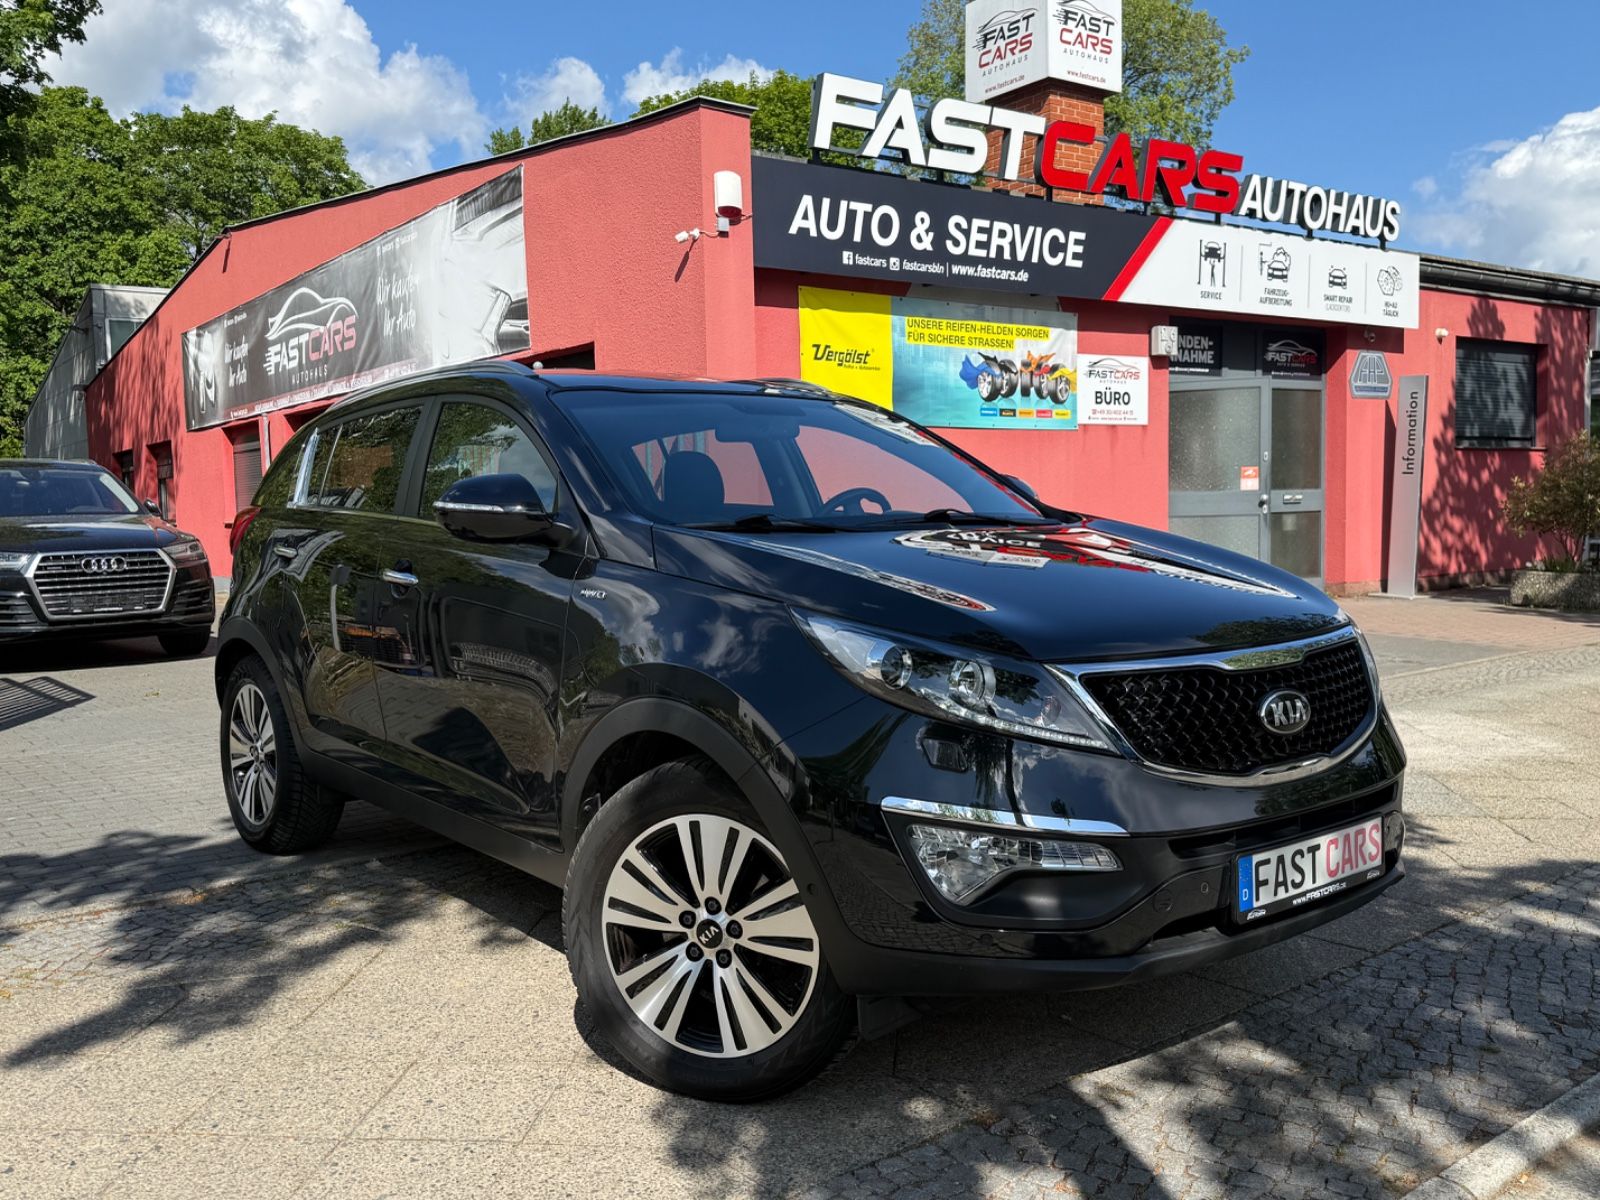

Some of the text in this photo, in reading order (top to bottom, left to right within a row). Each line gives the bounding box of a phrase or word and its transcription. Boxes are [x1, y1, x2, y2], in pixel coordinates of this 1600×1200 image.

[982, 13, 1035, 49] FAST
[1062, 9, 1115, 36] FAST
[978, 32, 1033, 69] CARS
[1059, 27, 1113, 56] CARS
[982, 54, 1028, 77] AUTOHAUS
[1063, 48, 1109, 64] AUTOHAUS
[985, 74, 1025, 94] www.fastcars.de
[1066, 69, 1106, 84] www.fastcars.de
[1238, 174, 1401, 242] AUTOHAUS
[788, 194, 1086, 268] AUTO & SERVICE
[855, 253, 887, 268] fastcars
[951, 263, 1029, 282] www.fastcars.de
[1200, 290, 1222, 301] SERVICE
[1338, 295, 1353, 304] REPAIR
[907, 318, 1049, 339] UNSERE REIFEN-HELDEN SORGEN
[907, 331, 1014, 349] FÜR SICHERE STRASSEN!
[1177, 335, 1214, 350] NDEN-
[812, 344, 871, 367] Vergölst
[1095, 386, 1131, 406] BÜRO
[1402, 391, 1419, 475] Information
[1270, 698, 1307, 727] KIA
[1242, 888, 1249, 901] D
[699, 926, 719, 944] KIA
